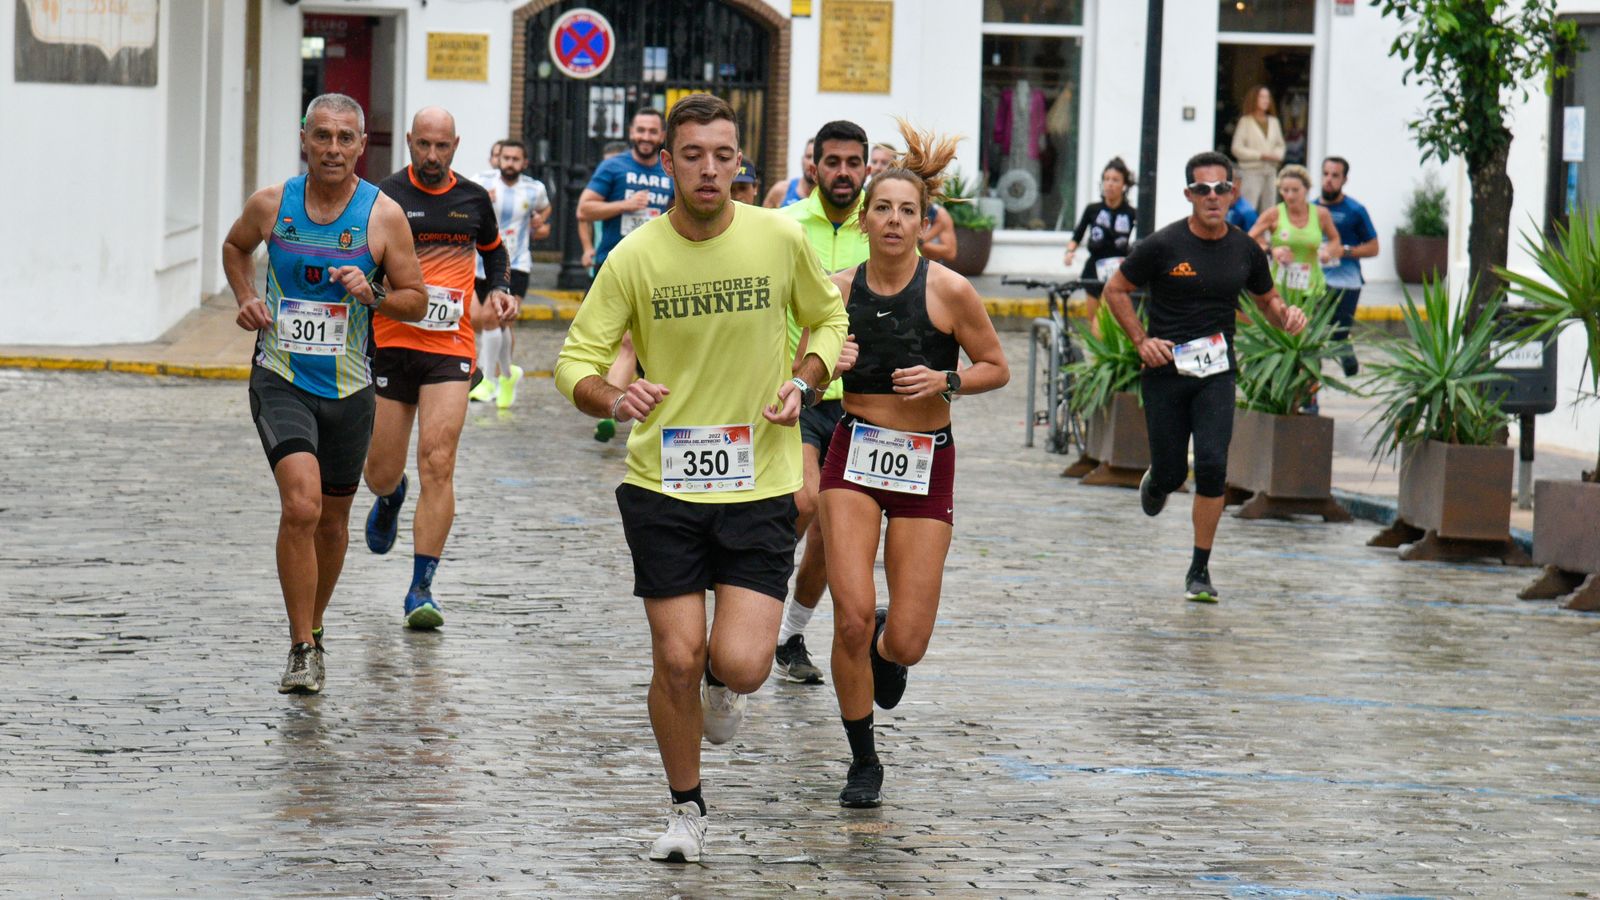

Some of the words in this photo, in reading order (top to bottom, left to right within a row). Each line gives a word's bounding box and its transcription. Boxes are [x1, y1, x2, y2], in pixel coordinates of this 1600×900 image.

[626, 171, 671, 190] RARE
[624, 189, 669, 206] FRM
[651, 277, 753, 299] ATHLETCORE
[651, 287, 771, 320] RUNNER
[291, 318, 326, 342] 301
[1193, 352, 1212, 369] 14
[673, 430, 692, 439] XIII
[863, 429, 880, 439] XIII
[682, 449, 729, 477] 350
[868, 448, 909, 477] 109
